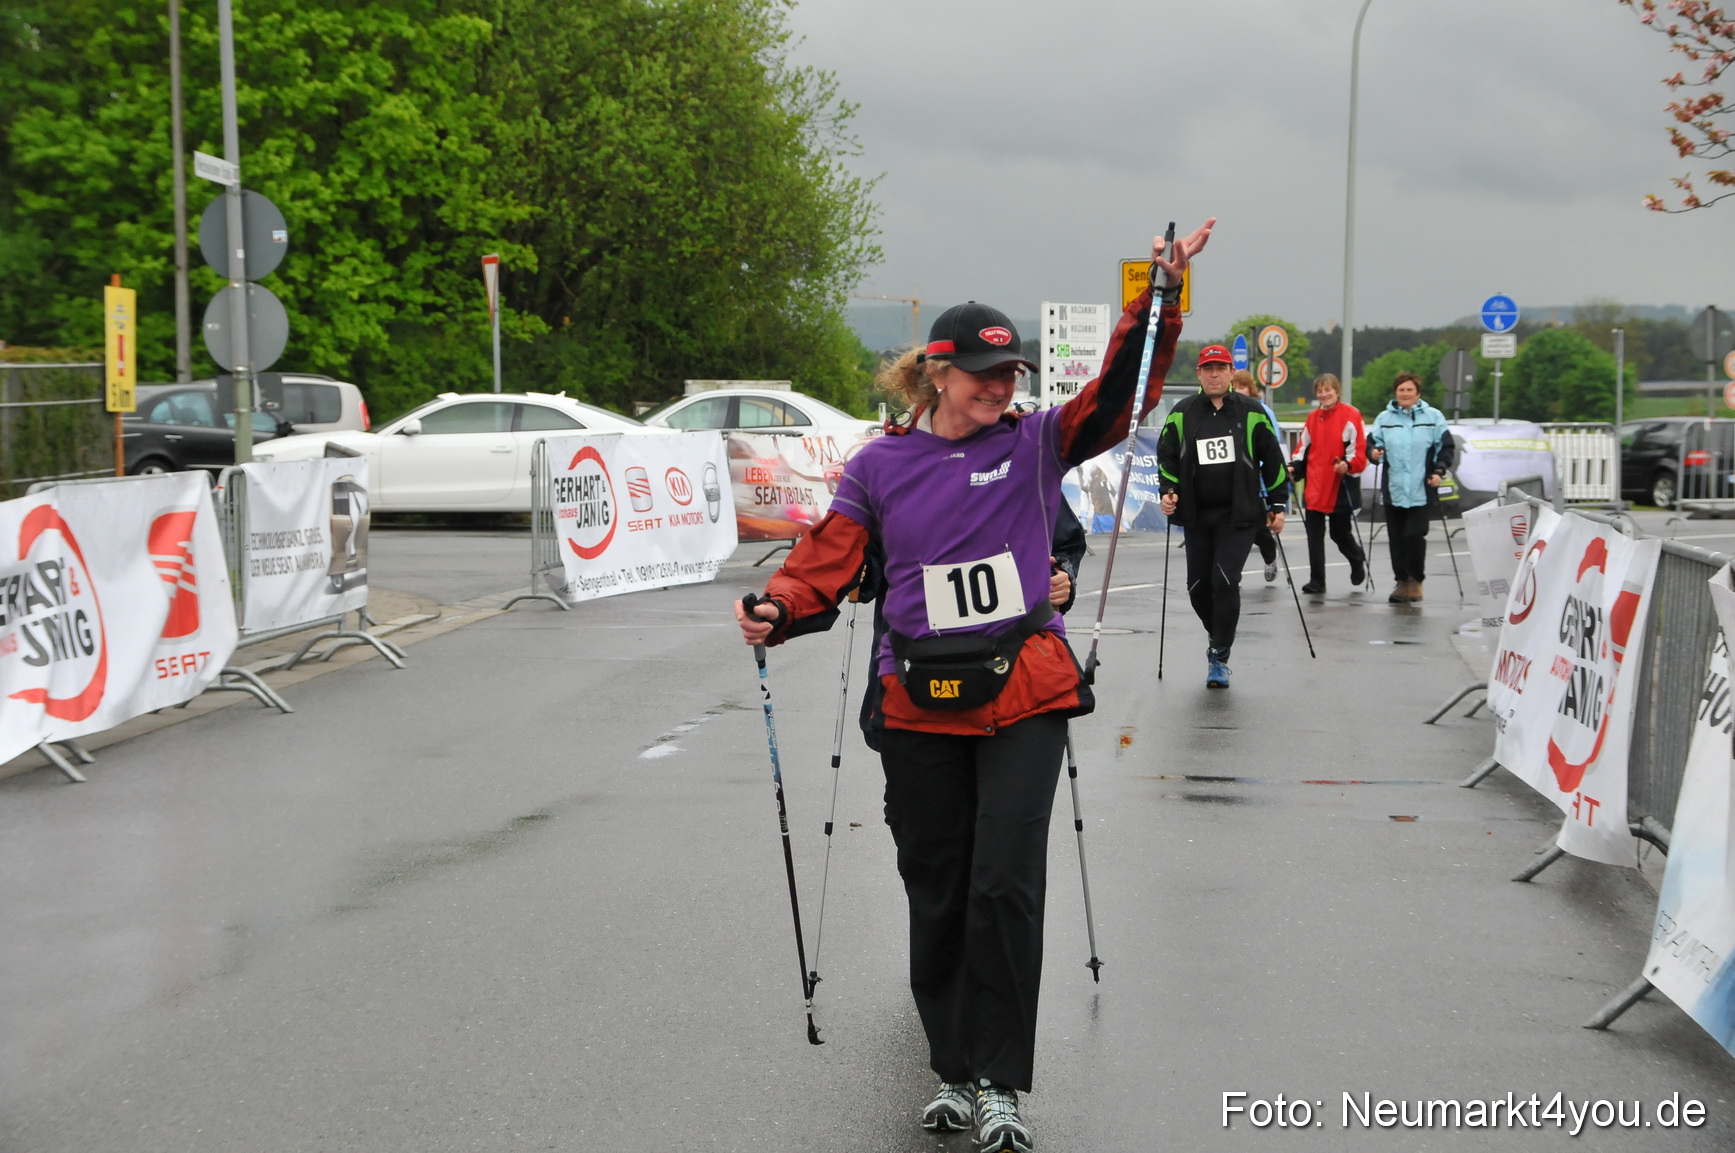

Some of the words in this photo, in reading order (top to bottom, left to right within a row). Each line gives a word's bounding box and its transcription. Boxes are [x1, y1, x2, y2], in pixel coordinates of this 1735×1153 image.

[1206, 439, 1229, 460] 63
[554, 474, 601, 503] GERHART
[668, 476, 691, 497] KIA
[755, 486, 783, 505] SEAT
[627, 517, 663, 532] SEAT
[668, 514, 680, 527] KIA
[681, 511, 704, 526] MOTORS
[946, 562, 999, 618] 10
[155, 651, 210, 680] SEAT
[929, 679, 963, 698] CAT
